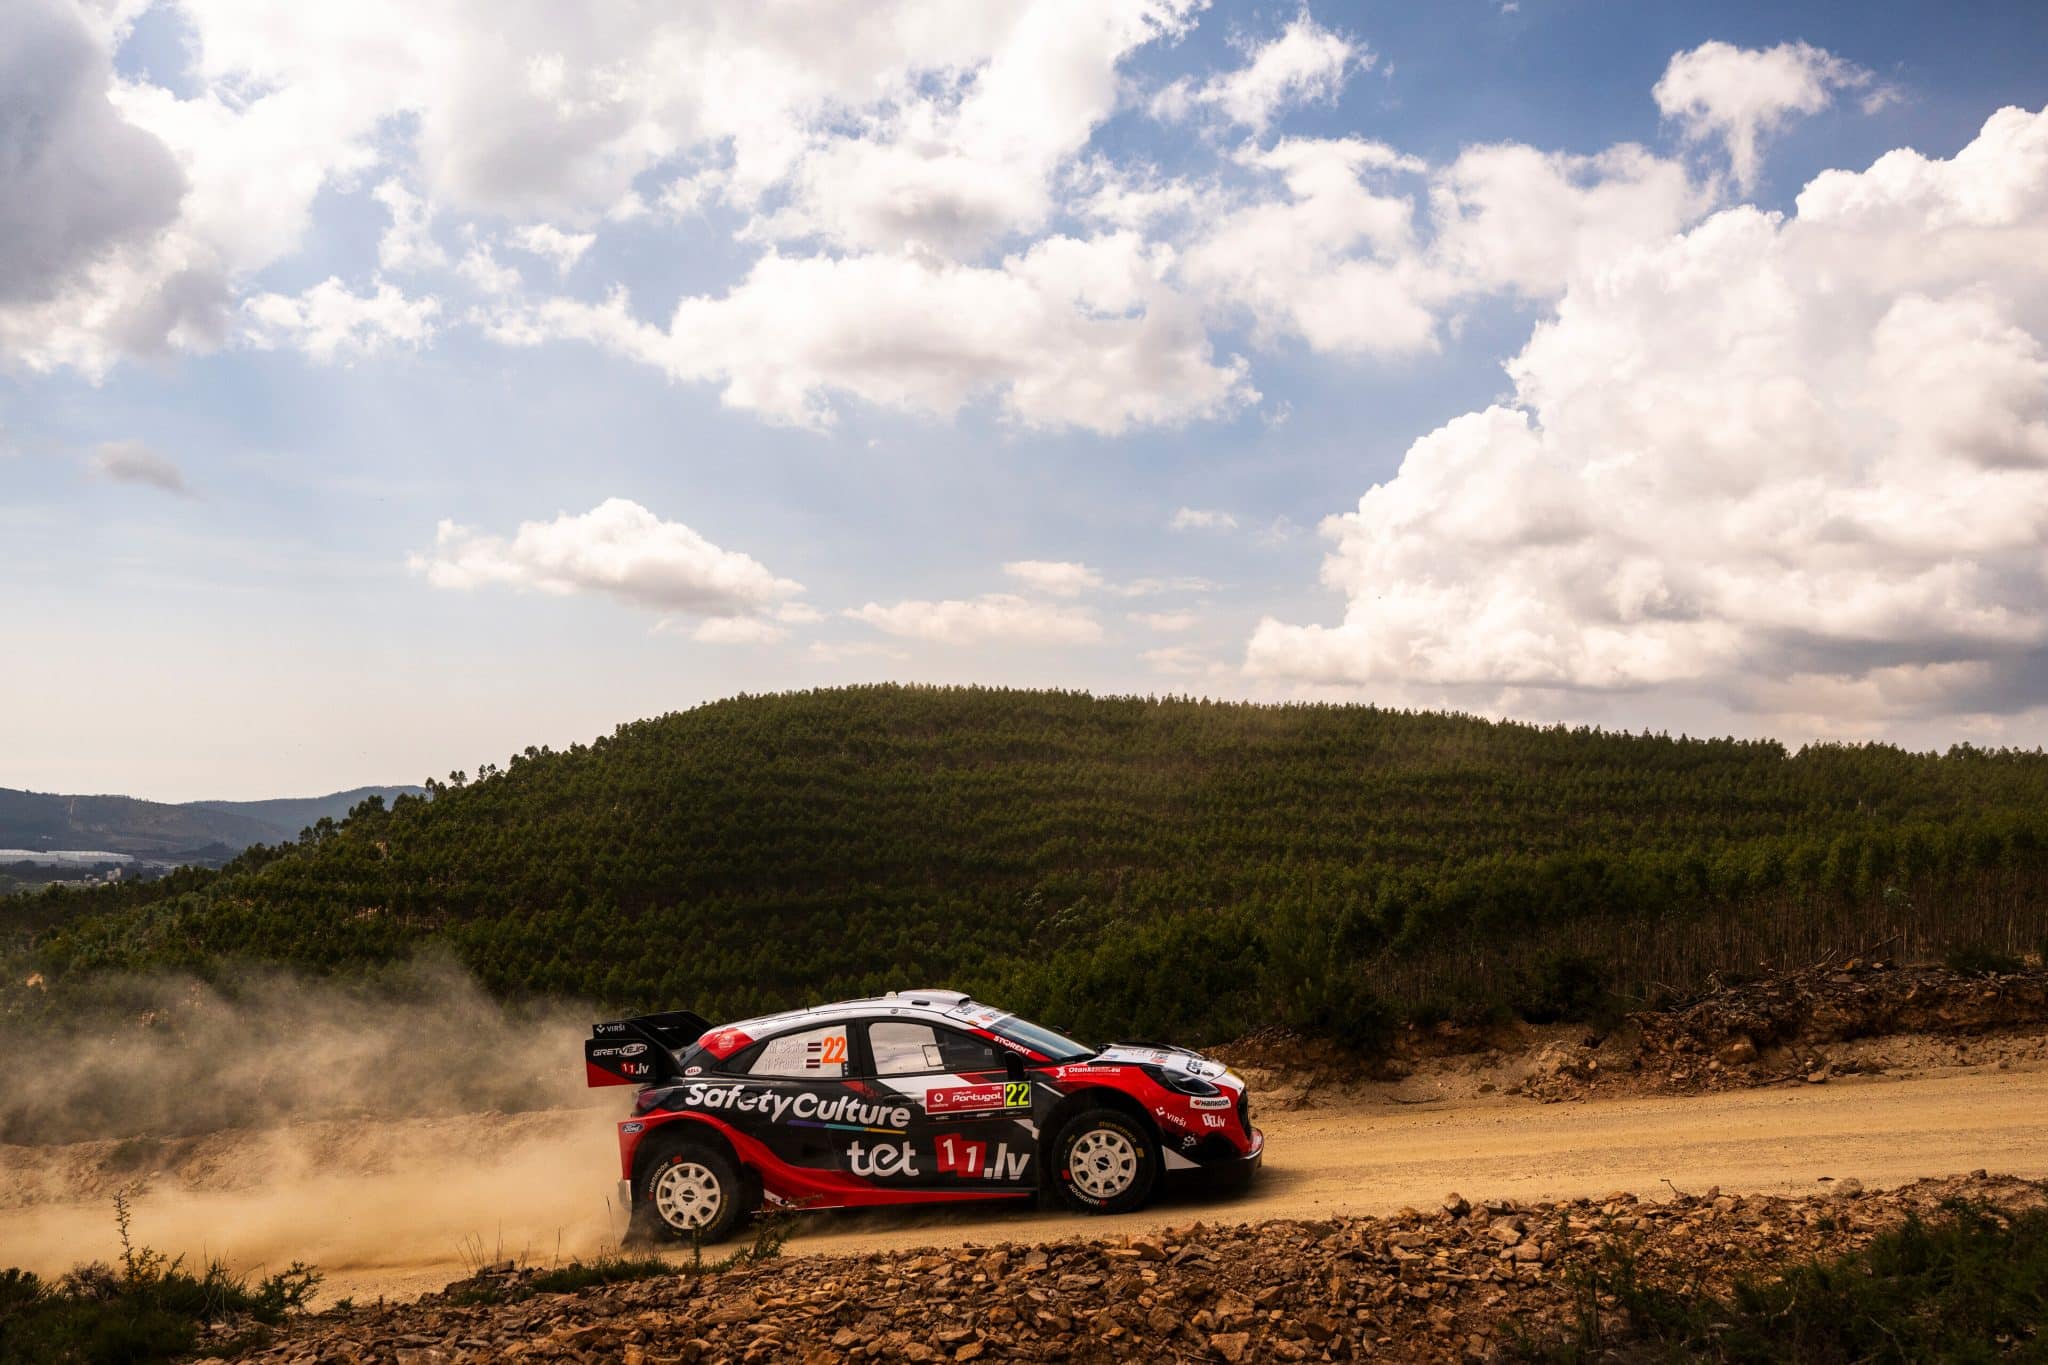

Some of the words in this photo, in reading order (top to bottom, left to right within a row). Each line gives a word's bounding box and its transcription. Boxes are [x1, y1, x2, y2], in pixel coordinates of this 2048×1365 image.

[822, 1036, 846, 1064] 22
[993, 1035, 1032, 1056] STORENT
[621, 1062, 650, 1075] 11.lv
[685, 1083, 912, 1128] SafetyCulture
[952, 1091, 1003, 1103] Portugal
[1006, 1083, 1030, 1107] 22
[1167, 1112, 1187, 1128] VIRŠI
[847, 1140, 920, 1177] tet
[940, 1137, 1031, 1180] 11.lv
